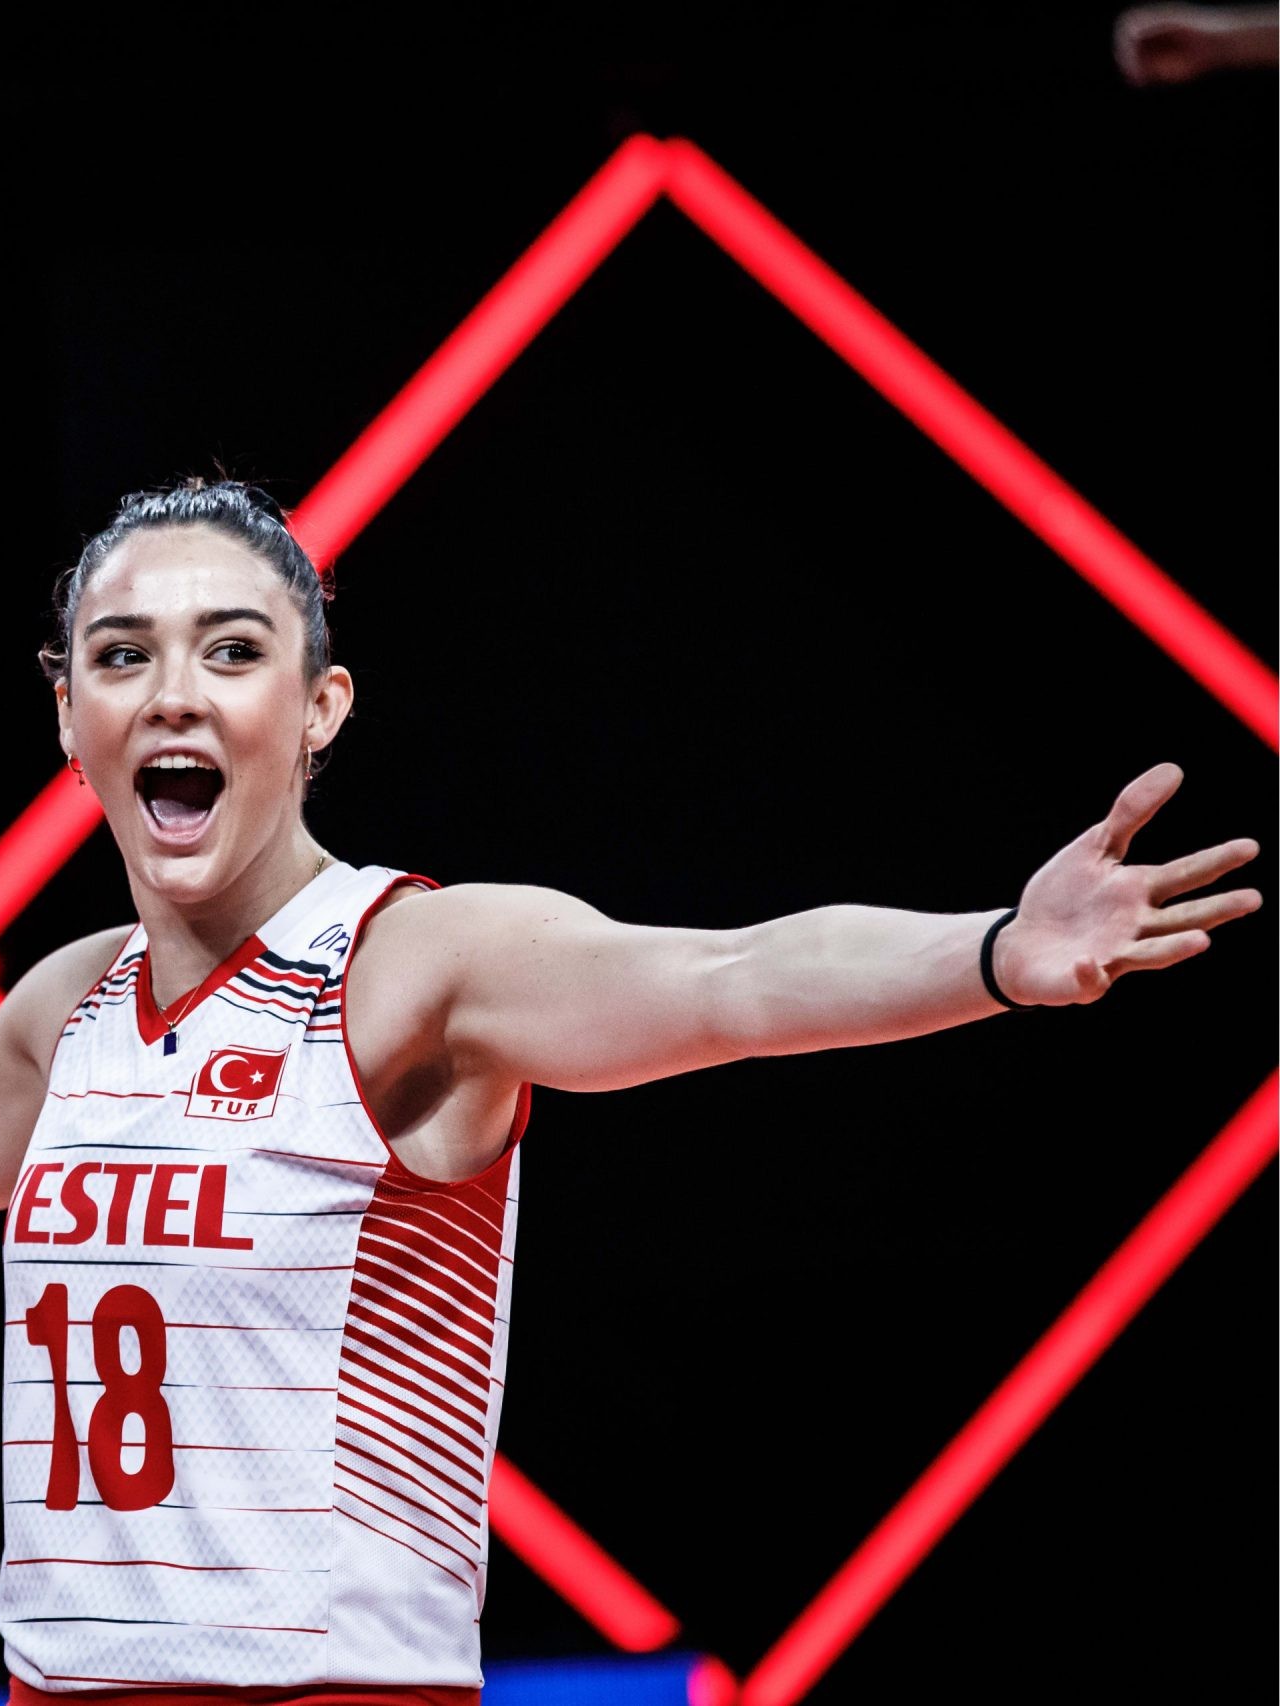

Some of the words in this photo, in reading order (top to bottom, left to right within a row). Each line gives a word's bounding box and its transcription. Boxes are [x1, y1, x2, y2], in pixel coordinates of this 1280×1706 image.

[210, 1099, 258, 1116] TUR
[3, 1162, 254, 1250] ESTEL
[25, 1283, 175, 1512] 18
